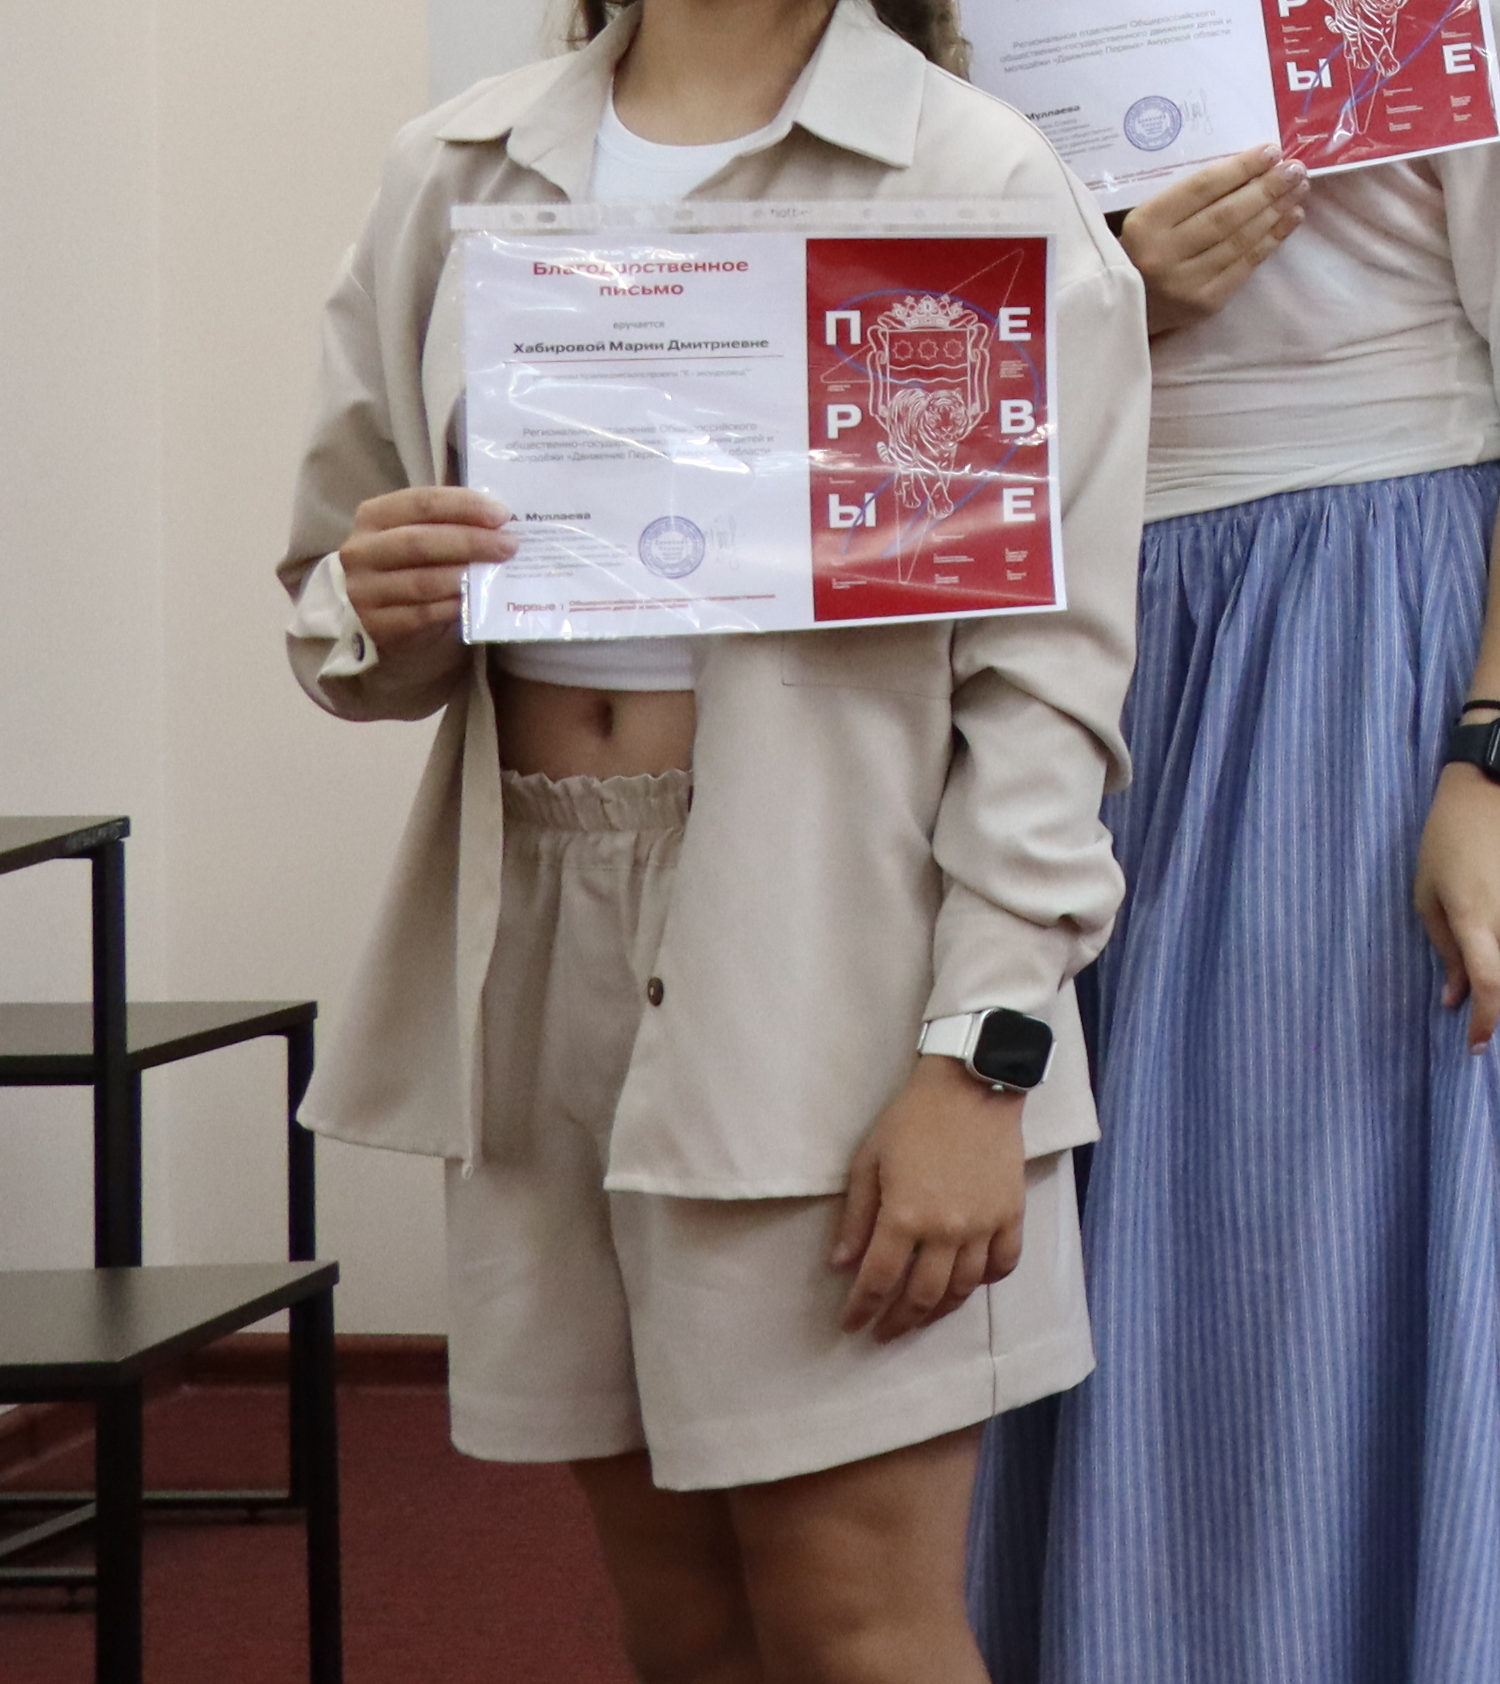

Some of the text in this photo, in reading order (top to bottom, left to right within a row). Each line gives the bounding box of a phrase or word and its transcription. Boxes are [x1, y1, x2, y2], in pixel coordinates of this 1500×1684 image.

[1286, 41, 1476, 92] Ы Е
[599, 282, 684, 298] письмо
[513, 335, 769, 356] Хабировой Марии Дмитриевне
[824, 306, 1033, 345] П Е
[826, 398, 1037, 439] Р В
[827, 486, 1036, 529] Ы Е
